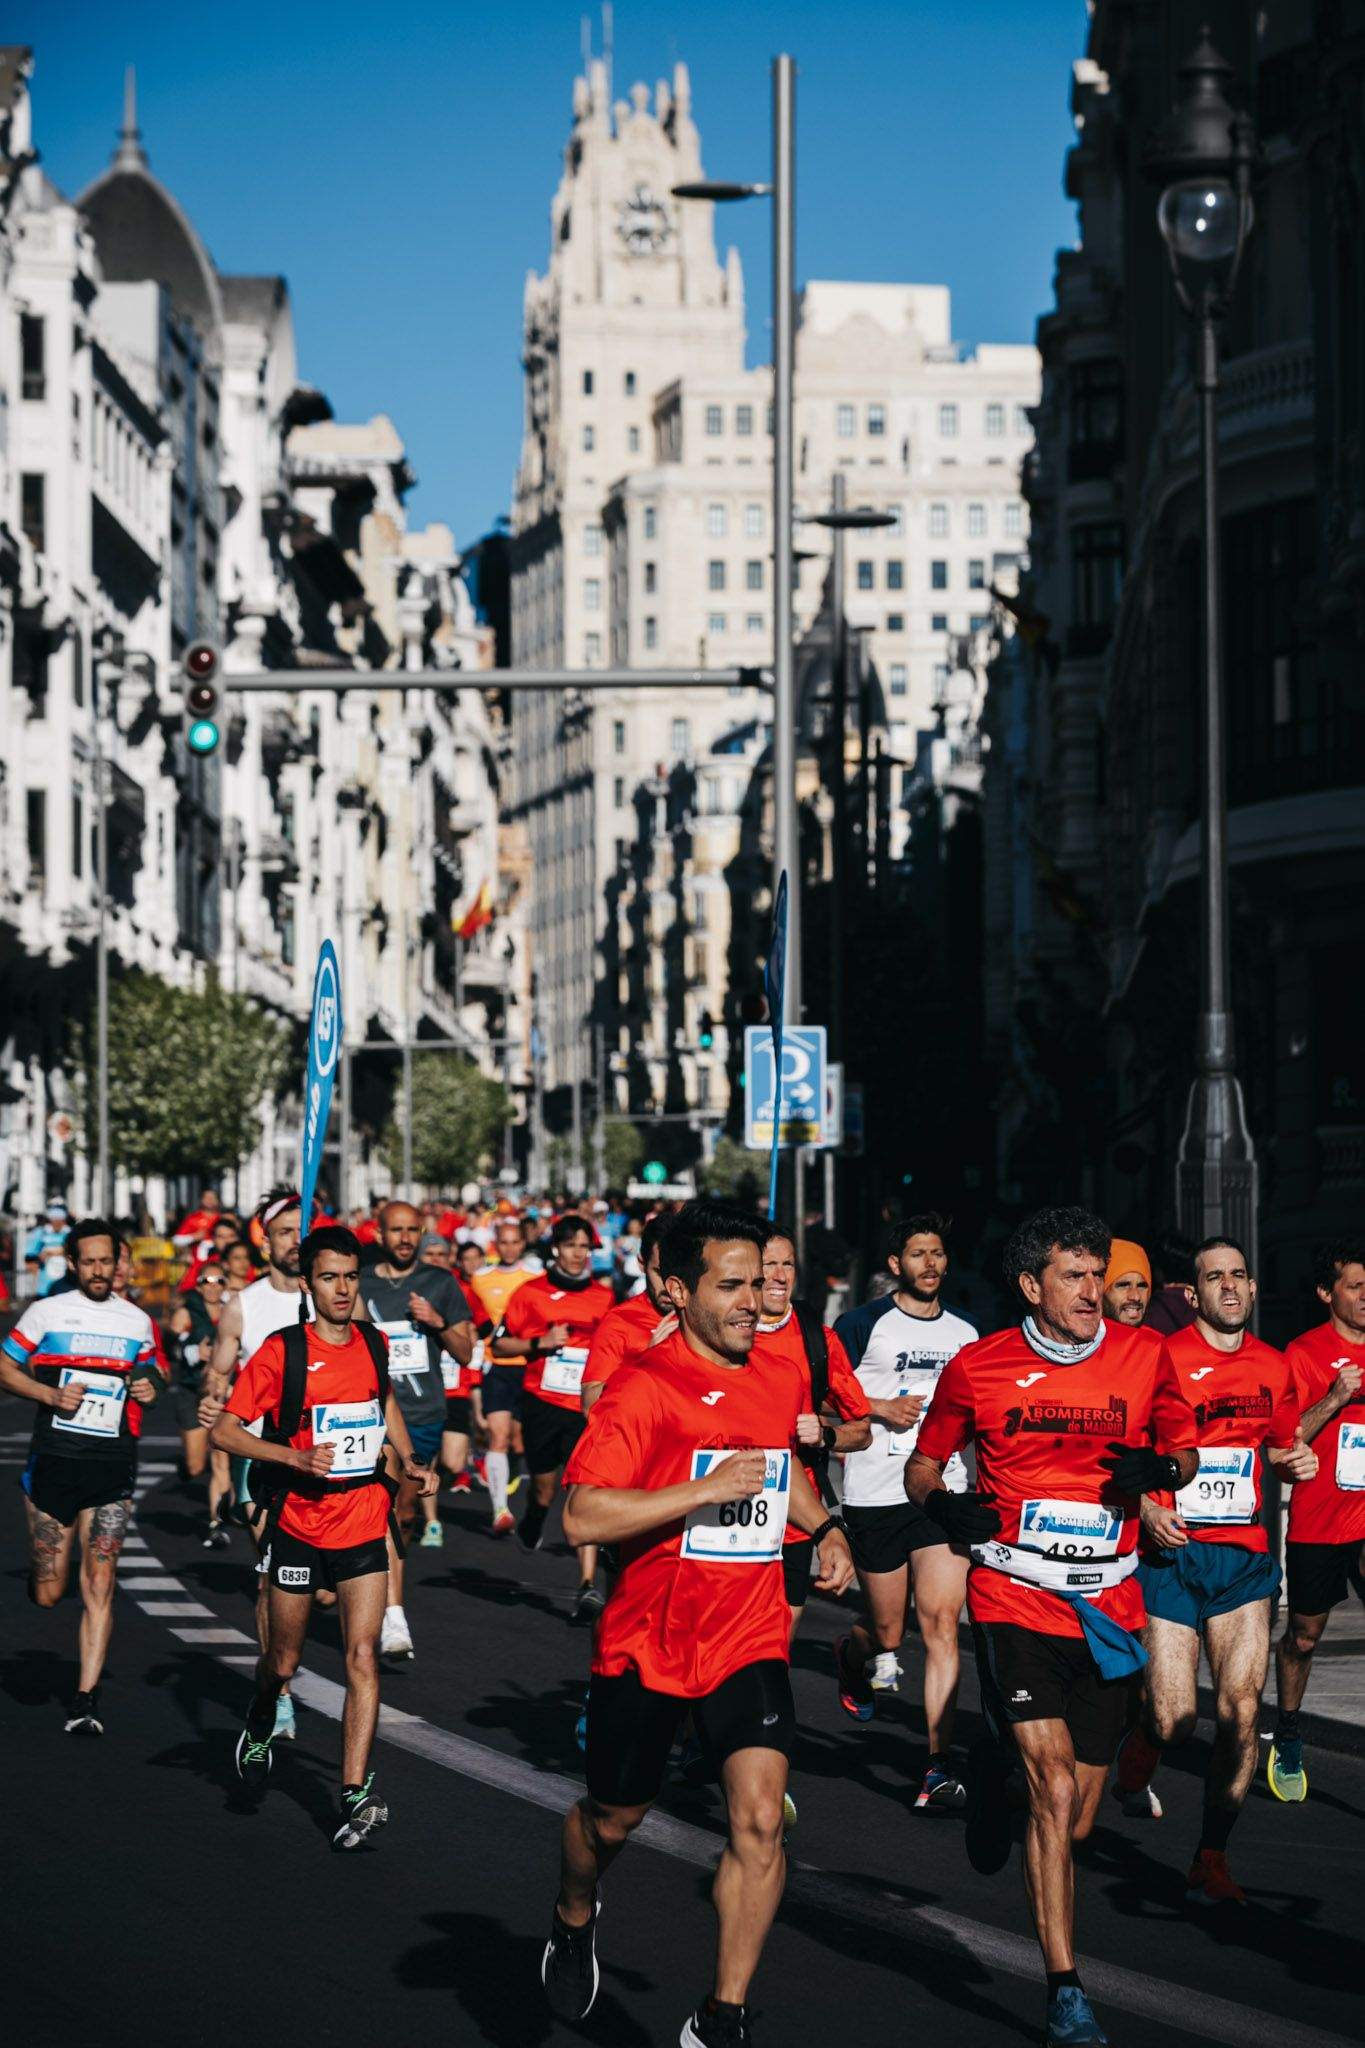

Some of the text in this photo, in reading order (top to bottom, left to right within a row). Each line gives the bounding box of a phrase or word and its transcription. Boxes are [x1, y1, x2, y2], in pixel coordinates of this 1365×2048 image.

[1213, 1397, 1270, 1408] BOMBEROS
[1033, 1407, 1123, 1422] BOMBEROS
[1067, 1420, 1123, 1436] de MADRID
[344, 1434, 365, 1454] 21
[1199, 1481, 1235, 1500] 997
[720, 1500, 768, 1527] 608
[1055, 1516, 1106, 1529] BOMBEROS
[281, 1569, 308, 1582] 6839
[1079, 1575, 1101, 1583] UTMB
